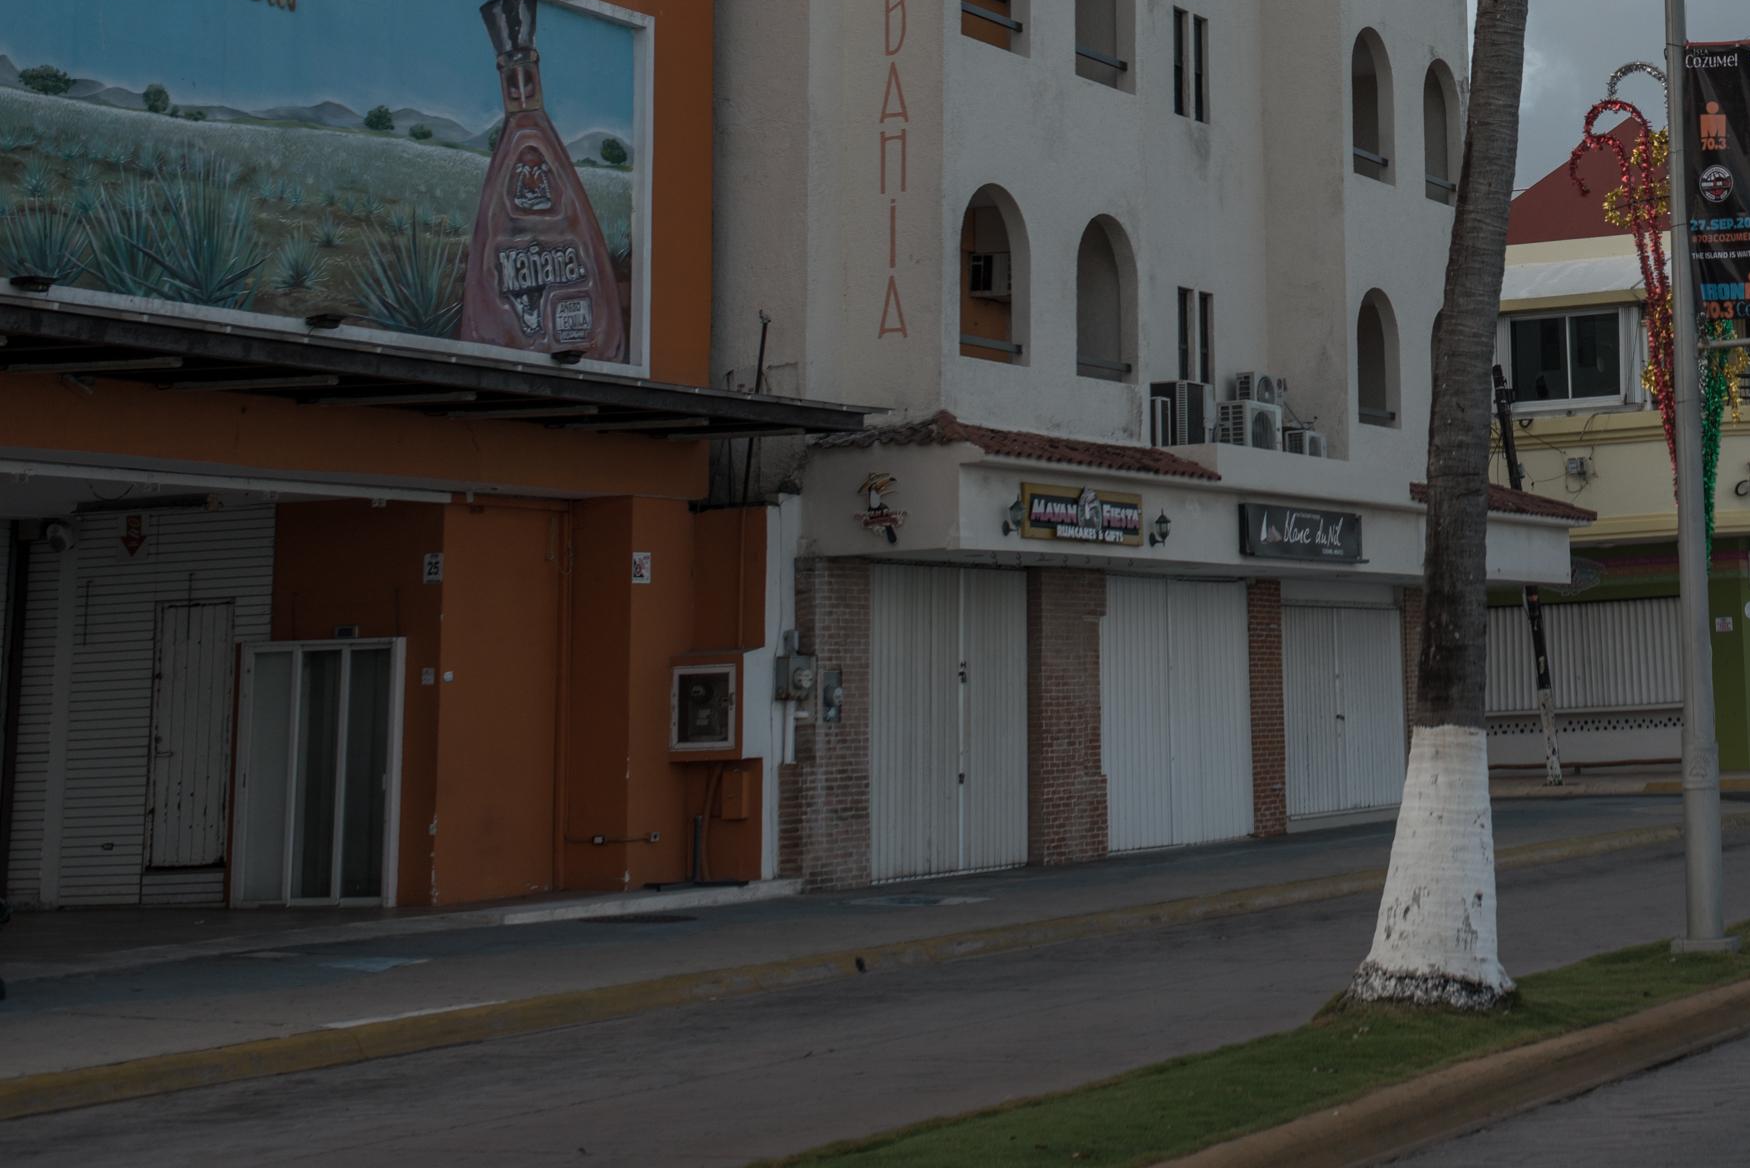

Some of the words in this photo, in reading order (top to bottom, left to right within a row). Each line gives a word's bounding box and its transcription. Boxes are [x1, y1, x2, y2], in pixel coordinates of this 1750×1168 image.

[1700, 137, 1728, 151] 70.3
[1705, 251, 1728, 260] ISLAND
[1729, 250, 1736, 259] IS
[1030, 498, 1078, 524] MAYAN
[1102, 503, 1140, 529] FIESTA
[1104, 529, 1124, 543] GIFTS
[426, 560, 441, 577] 25
